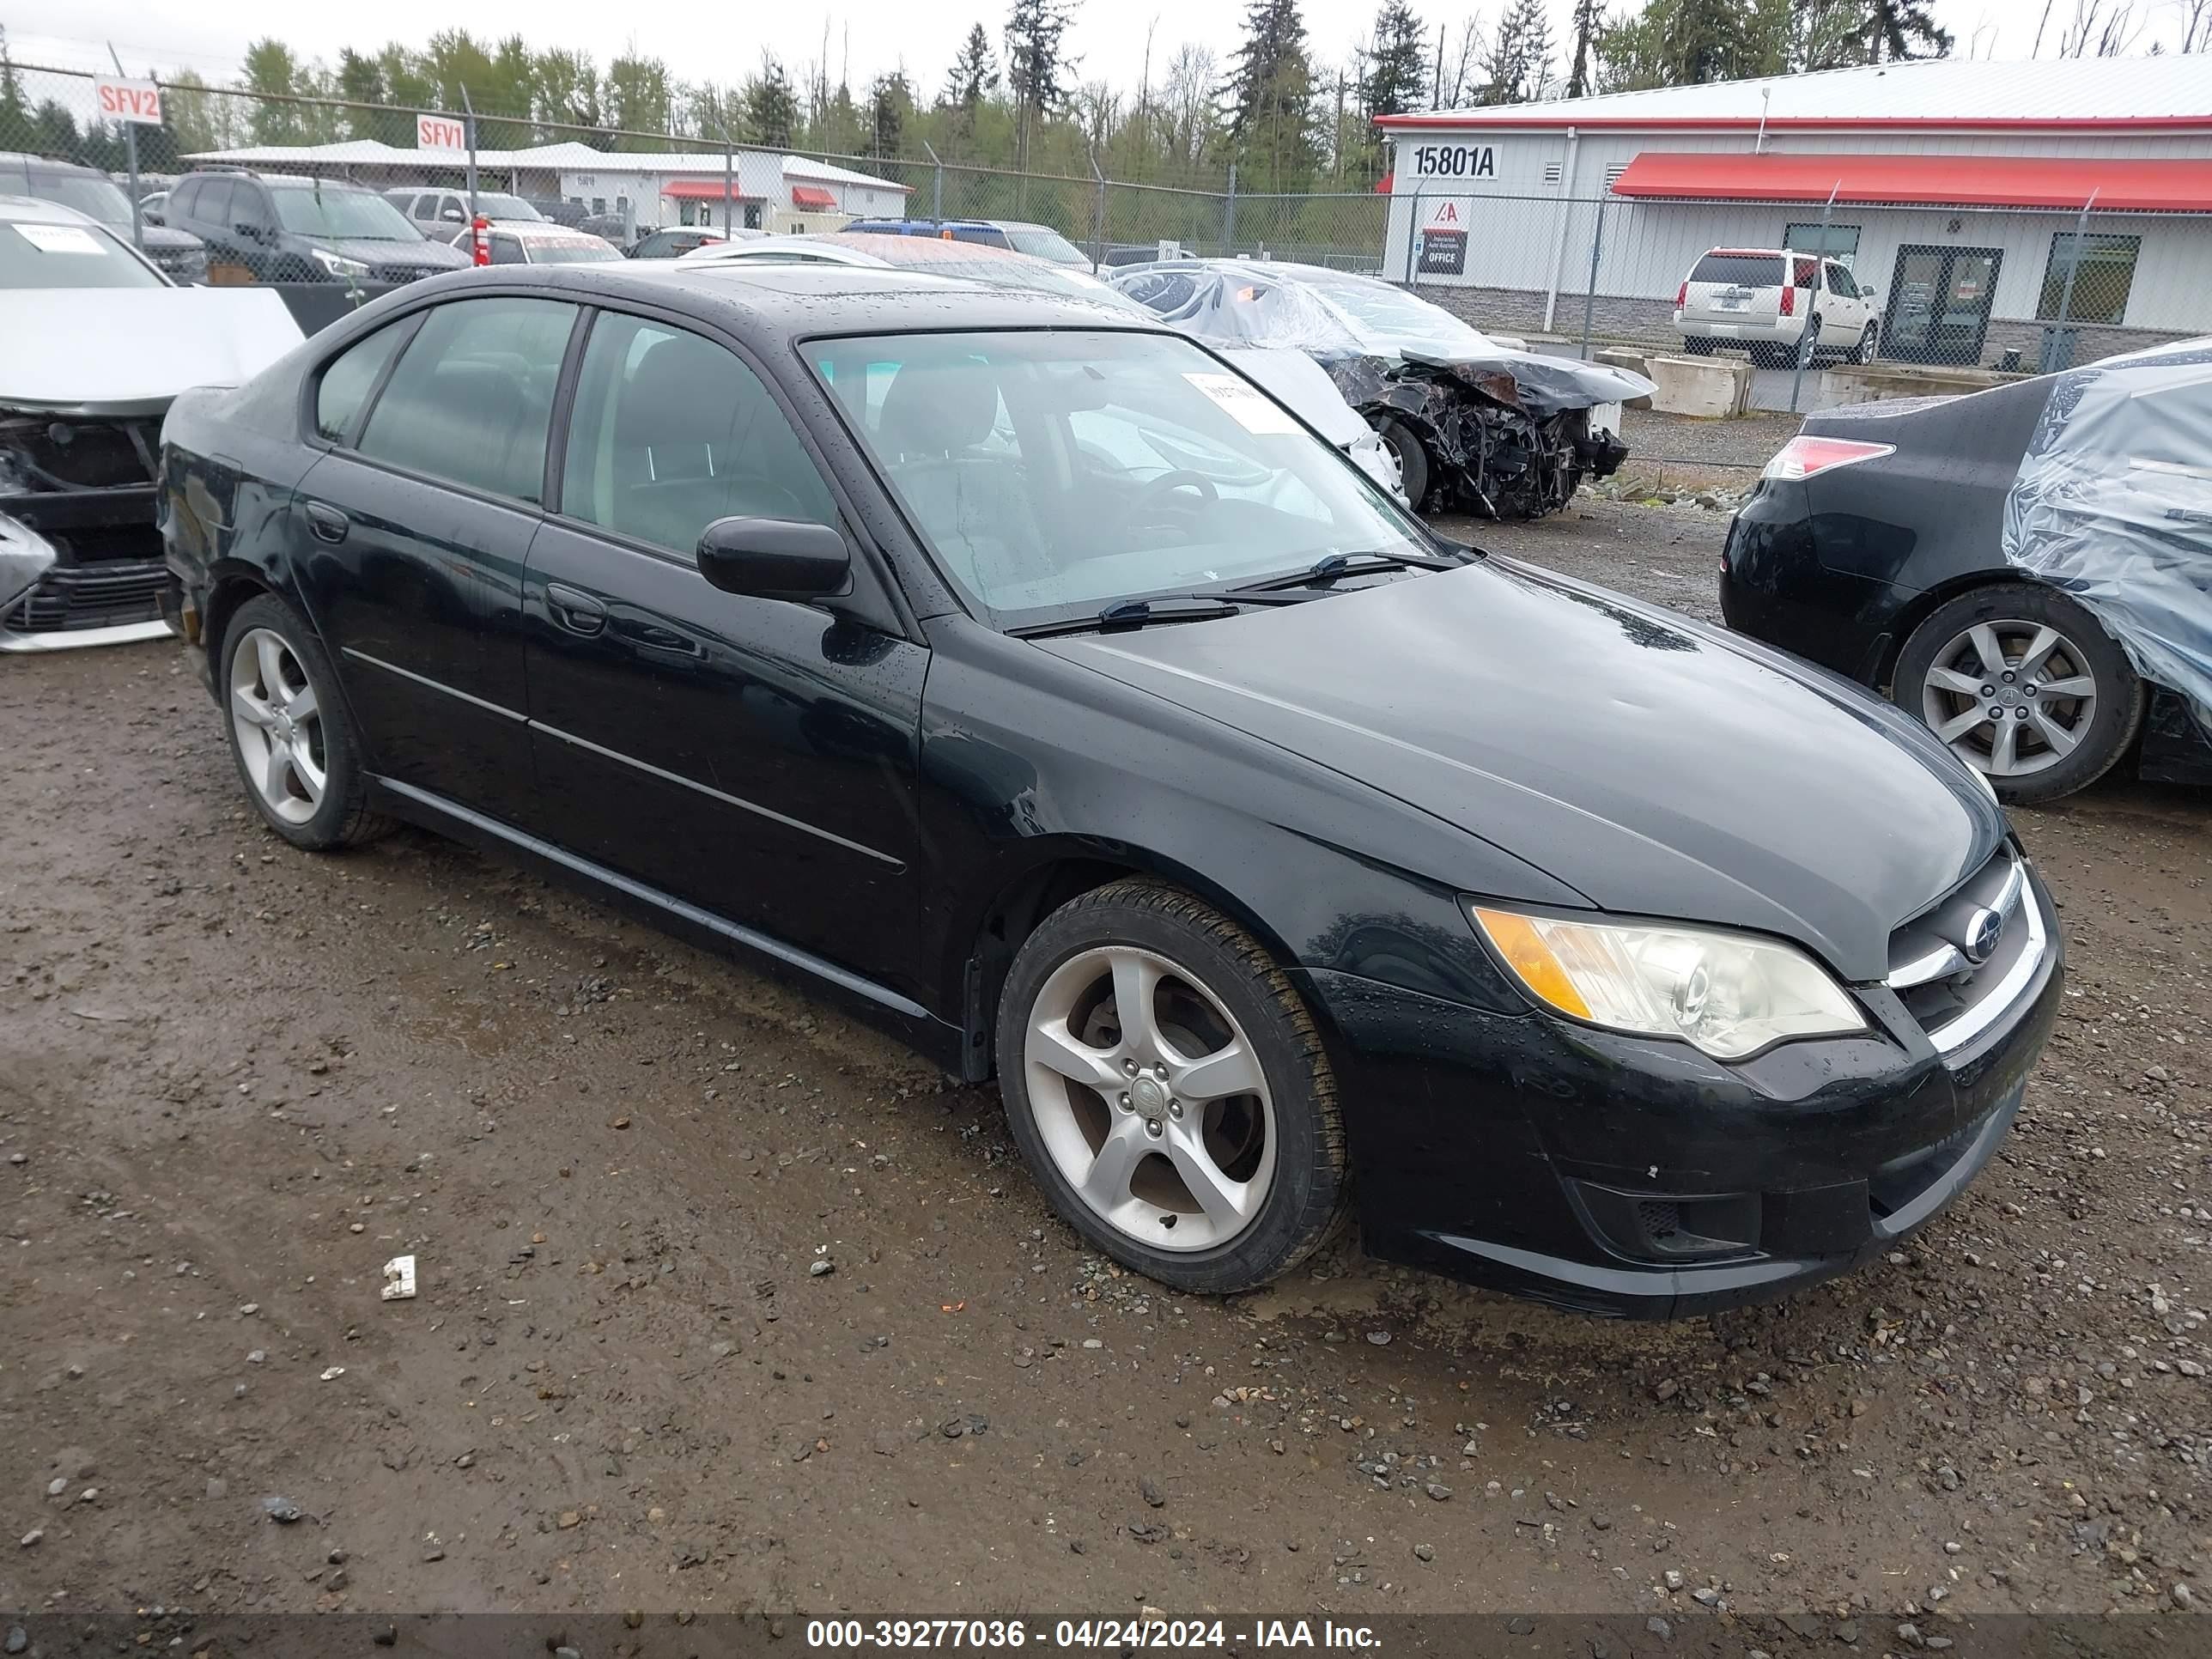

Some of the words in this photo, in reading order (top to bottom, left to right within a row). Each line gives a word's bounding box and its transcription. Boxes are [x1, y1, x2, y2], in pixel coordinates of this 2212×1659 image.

[99, 84, 158, 117] SFV2
[421, 120, 462, 149] SFV1
[1414, 146, 1494, 176] 15801A
[1428, 252, 1456, 263] OFFICE
